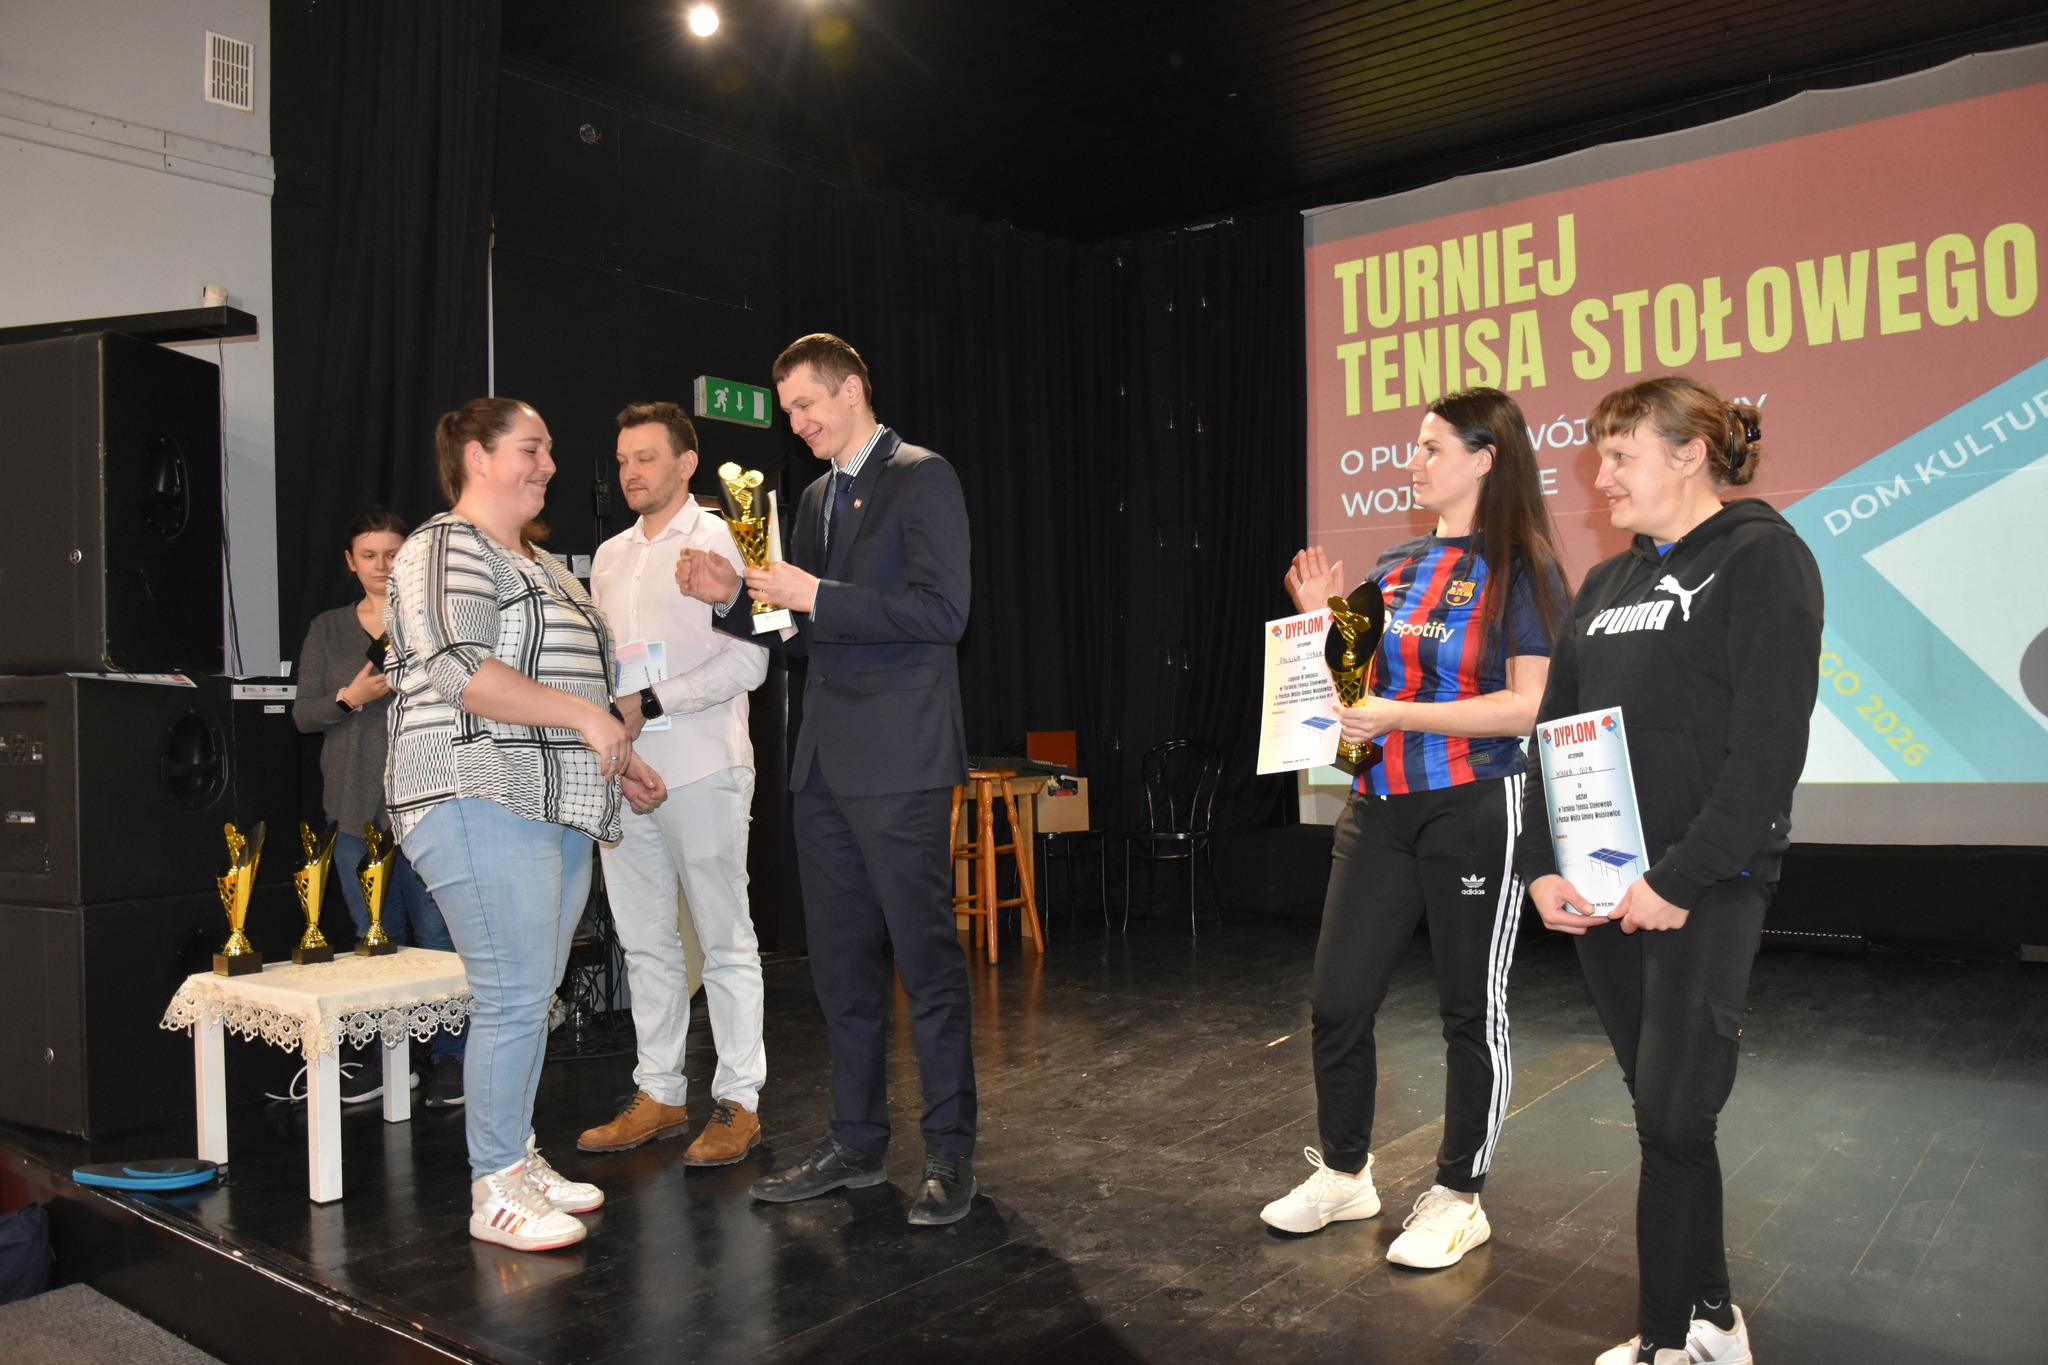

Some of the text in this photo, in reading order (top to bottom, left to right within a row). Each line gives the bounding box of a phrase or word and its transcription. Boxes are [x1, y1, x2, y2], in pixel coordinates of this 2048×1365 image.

[1334, 213, 1577, 336] TURNIEJ
[1336, 222, 2040, 417] TENISA STOŁOWEGO
[1340, 449, 1364, 476] O
[1823, 470, 1912, 537] DOM
[1285, 616, 1324, 639] DYPLOM
[1391, 618, 1456, 644] Spotify
[1586, 599, 1675, 636] PUMA
[1554, 720, 1597, 748] DYPLOM
[1855, 694, 1931, 767] 2026
